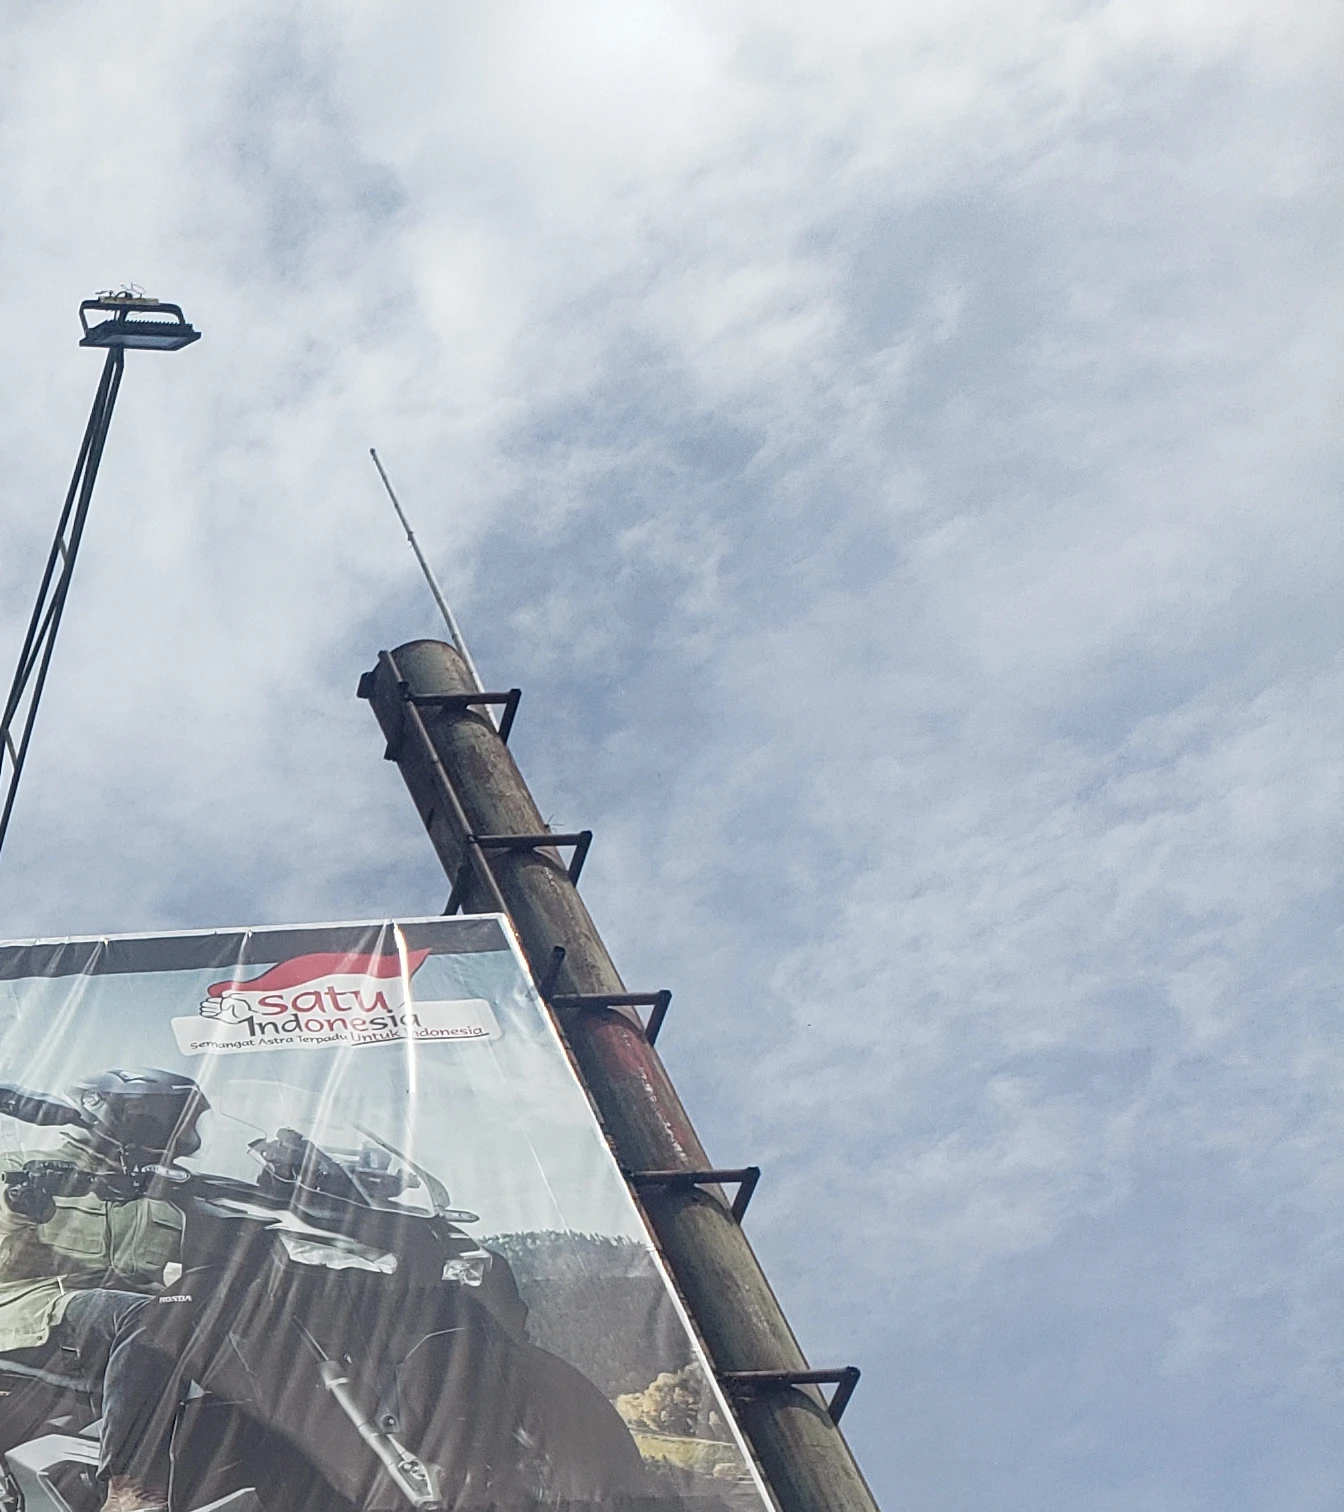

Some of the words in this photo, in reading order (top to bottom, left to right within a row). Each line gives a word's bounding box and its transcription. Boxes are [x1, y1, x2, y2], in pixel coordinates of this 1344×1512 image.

[257, 985, 388, 1014] satu
[258, 1036, 294, 1046] Astra
[297, 1033, 348, 1044] Terpadu
[351, 1028, 400, 1041] Untuk
[403, 1025, 484, 1038] ndonesia
